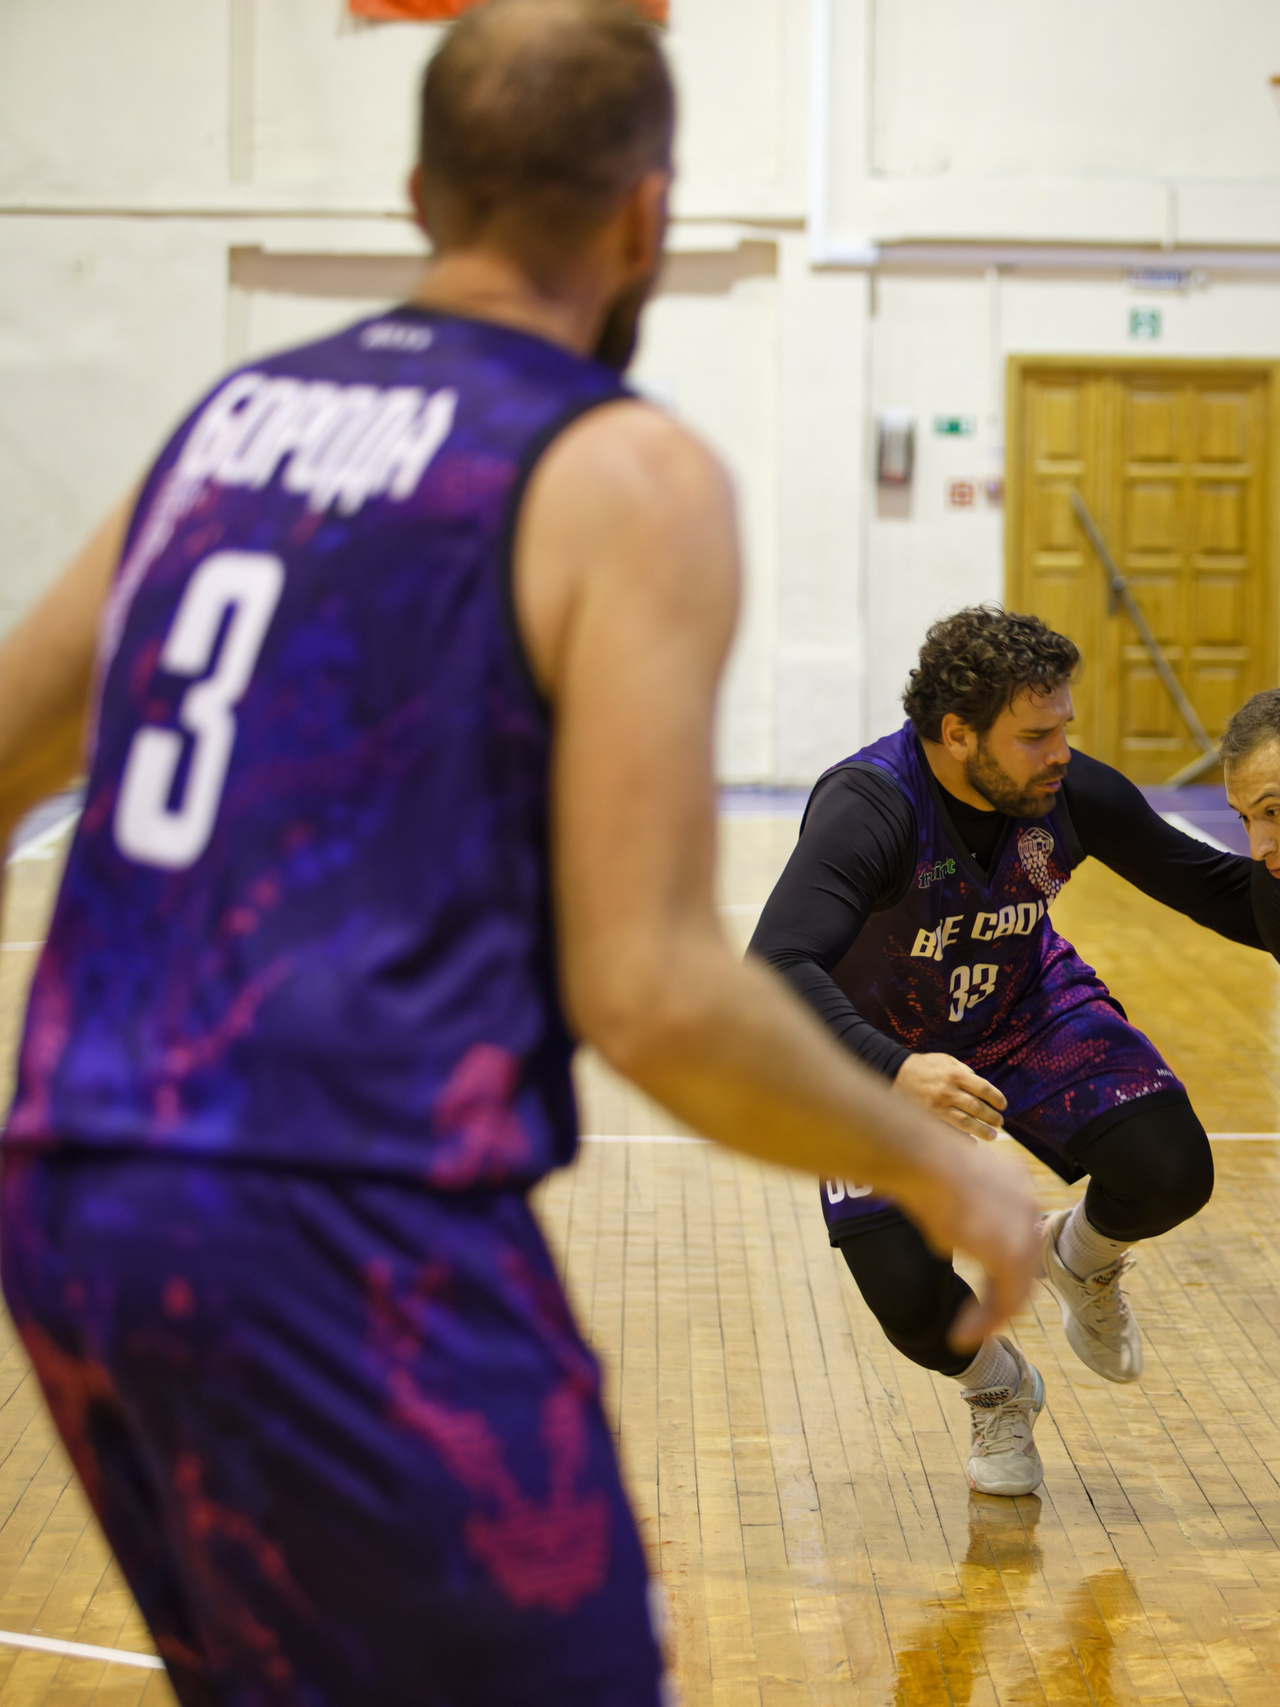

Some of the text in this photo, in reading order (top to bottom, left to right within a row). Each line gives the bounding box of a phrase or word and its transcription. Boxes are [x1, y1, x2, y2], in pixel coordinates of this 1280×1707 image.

[114, 550, 286, 871] 3
[910, 914, 964, 962] ВЕ
[948, 963, 999, 1022] 33
